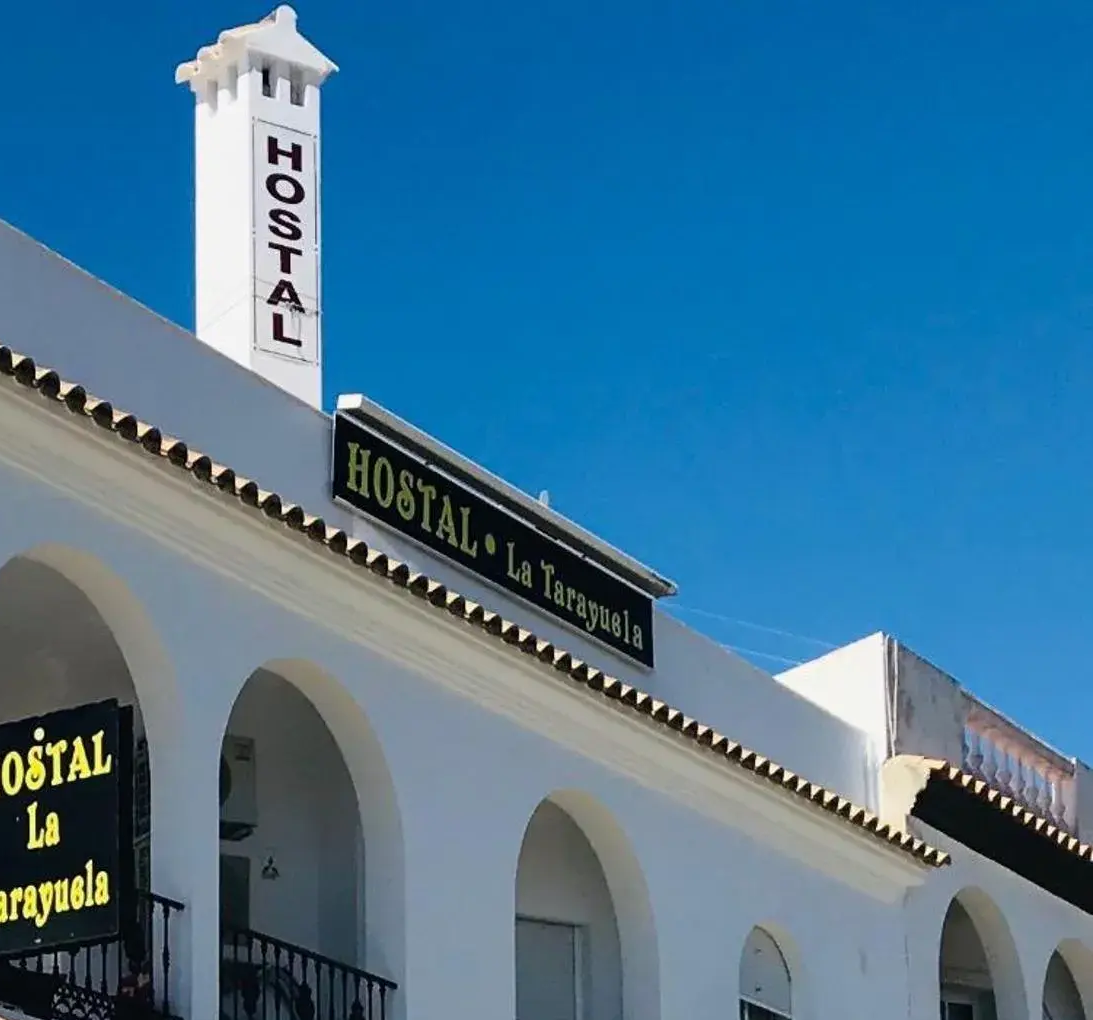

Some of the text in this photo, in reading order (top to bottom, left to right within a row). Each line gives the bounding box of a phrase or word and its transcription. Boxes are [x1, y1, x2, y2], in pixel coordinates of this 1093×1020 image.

[265, 135, 306, 347] HOSTAL
[346, 441, 644, 651] HOSTAL La Tarayuela
[26, 801, 61, 850] La
